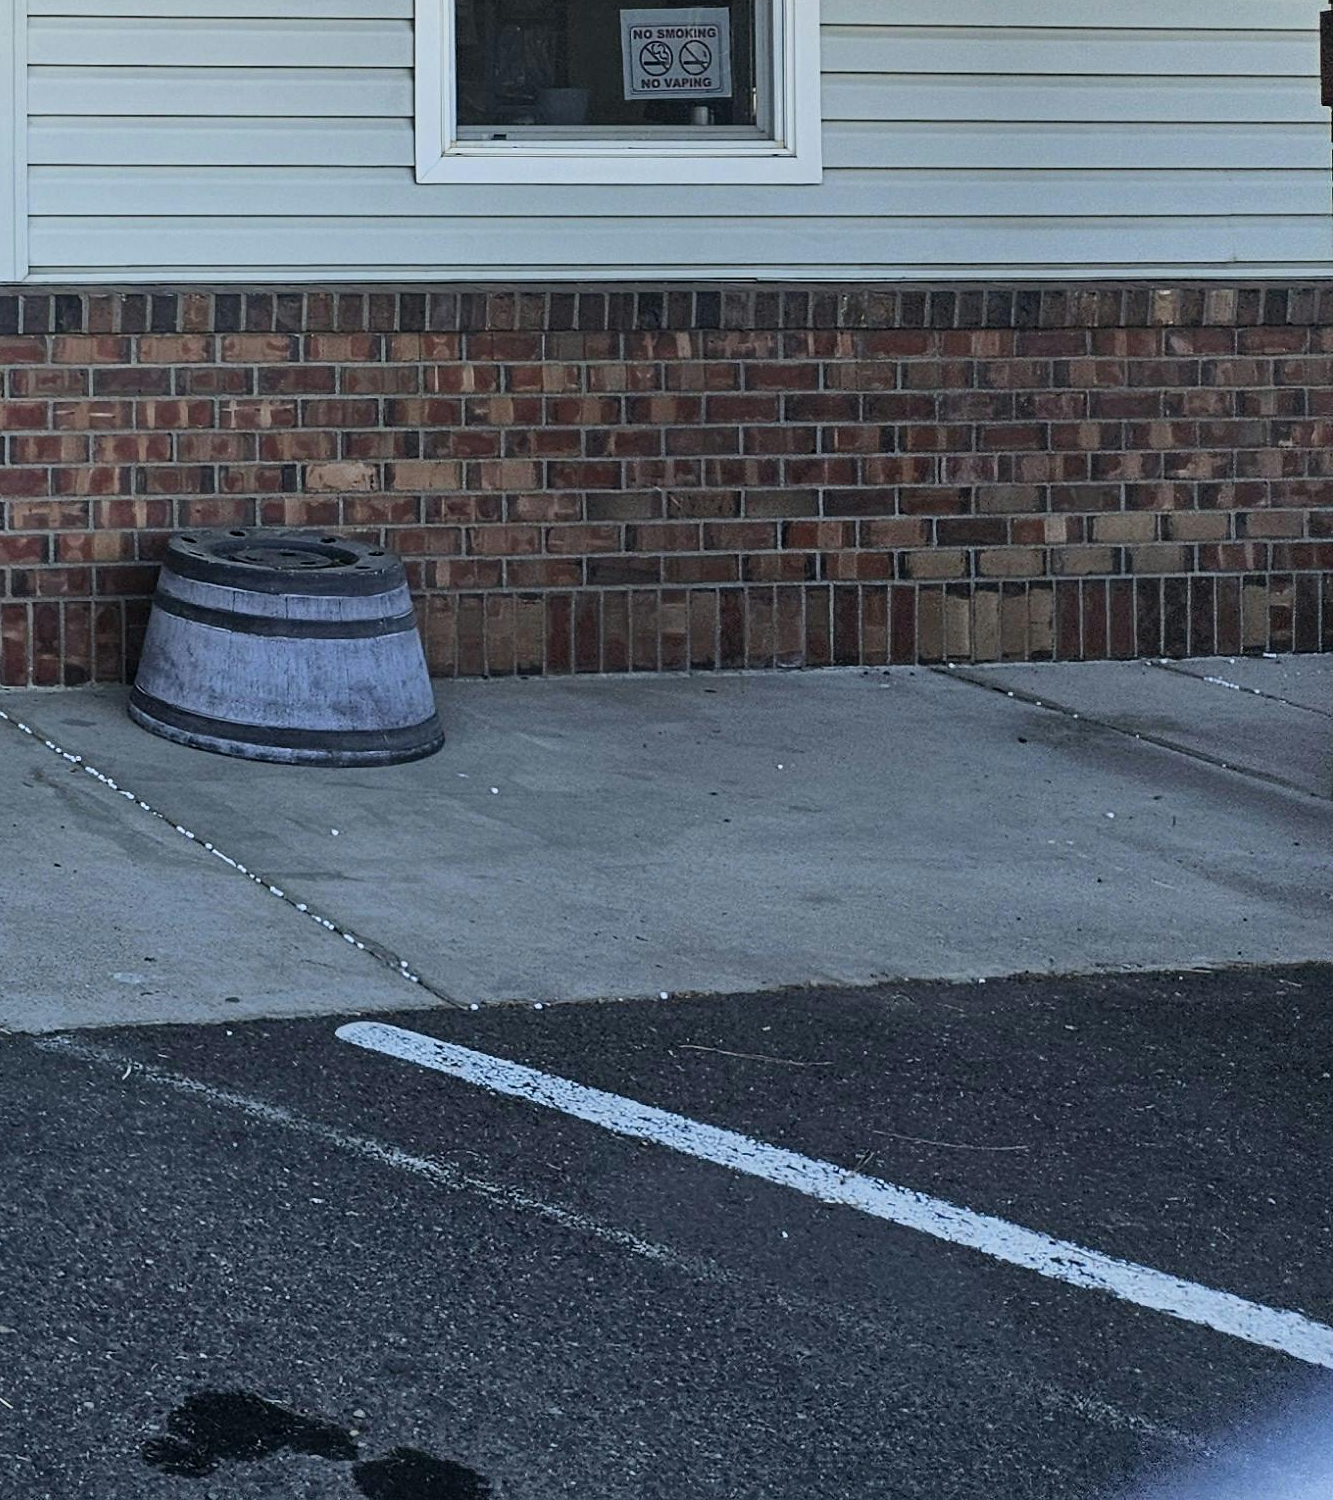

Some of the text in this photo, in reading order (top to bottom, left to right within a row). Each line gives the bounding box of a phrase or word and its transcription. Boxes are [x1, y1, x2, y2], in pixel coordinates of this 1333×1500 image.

[633, 28, 717, 39] NO SMOKING
[640, 77, 712, 89] NO VAPING
